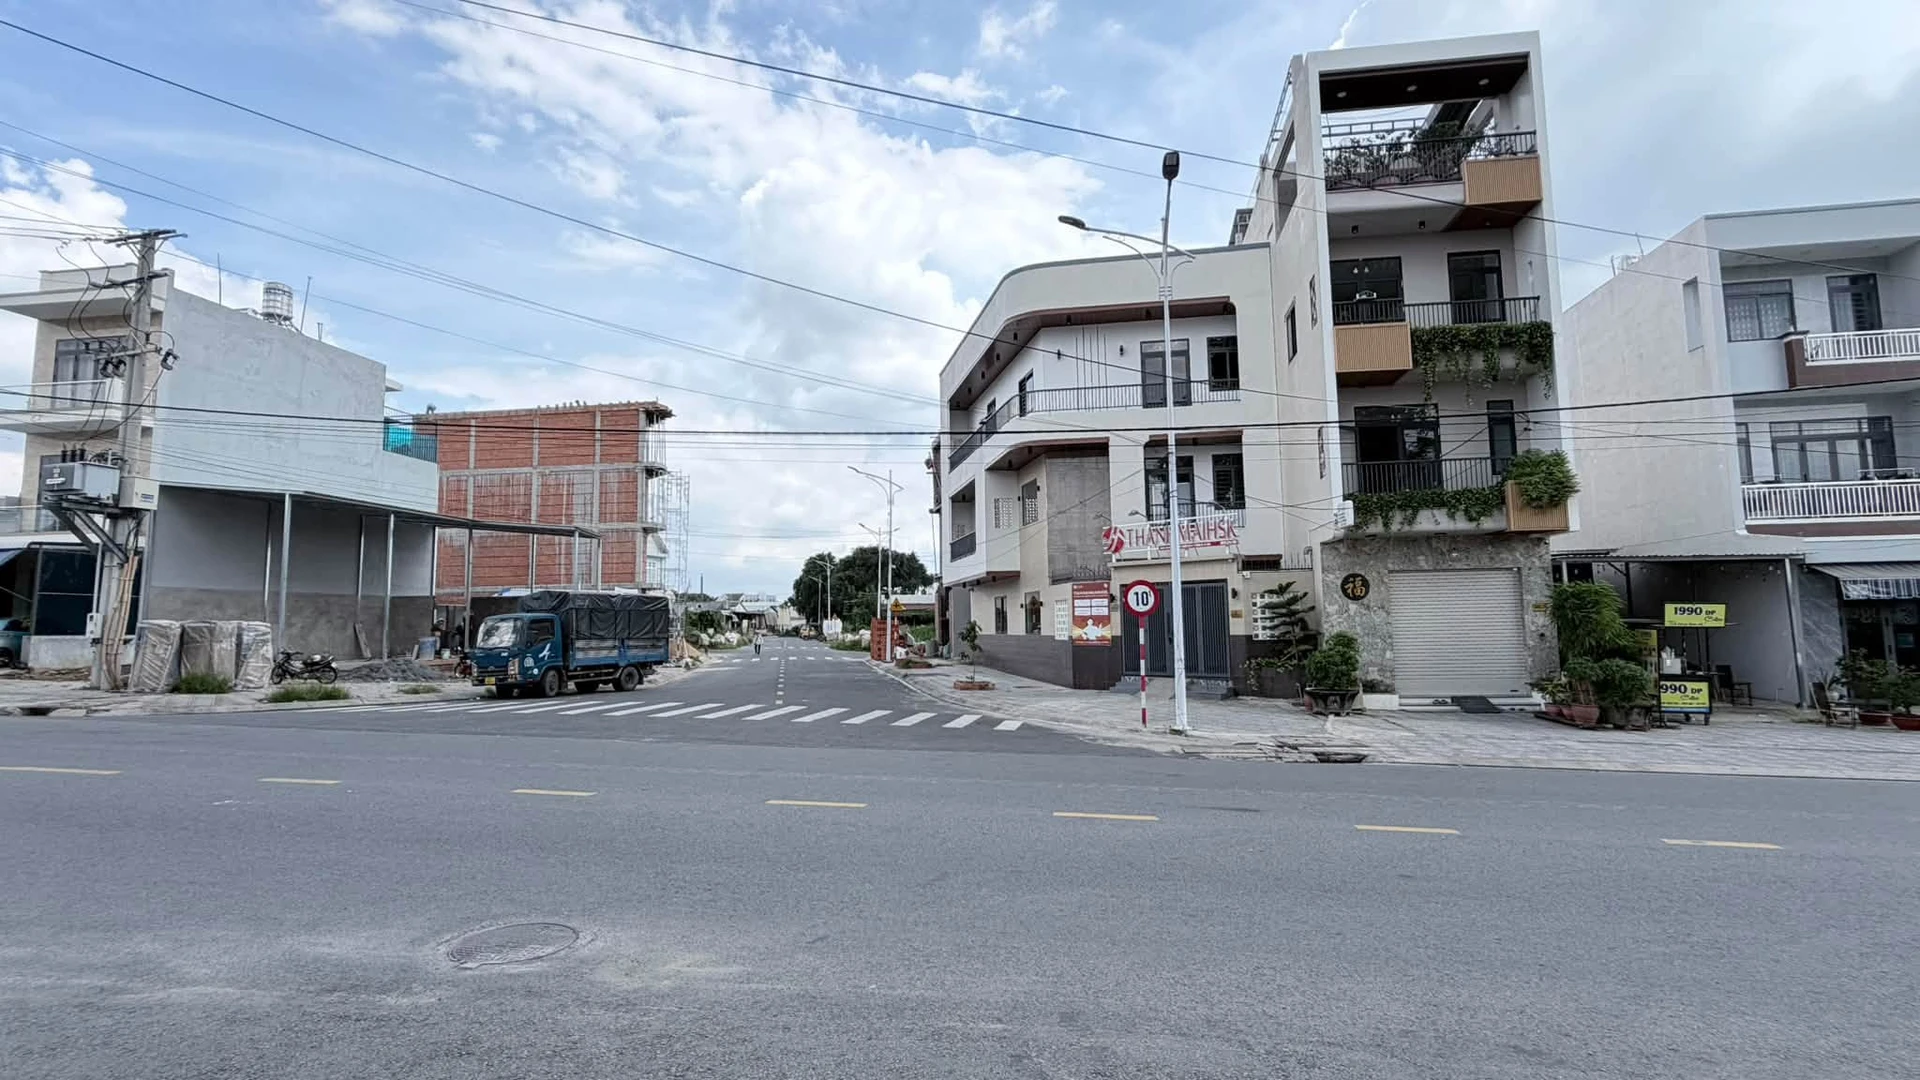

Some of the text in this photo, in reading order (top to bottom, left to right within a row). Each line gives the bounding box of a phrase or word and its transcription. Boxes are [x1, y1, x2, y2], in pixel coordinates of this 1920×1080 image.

[1126, 518, 1239, 547] THANMAIHSK
[1344, 576, 1365, 597] 福
[1674, 606, 1703, 615] 1990
[1660, 683, 1688, 694] 990
